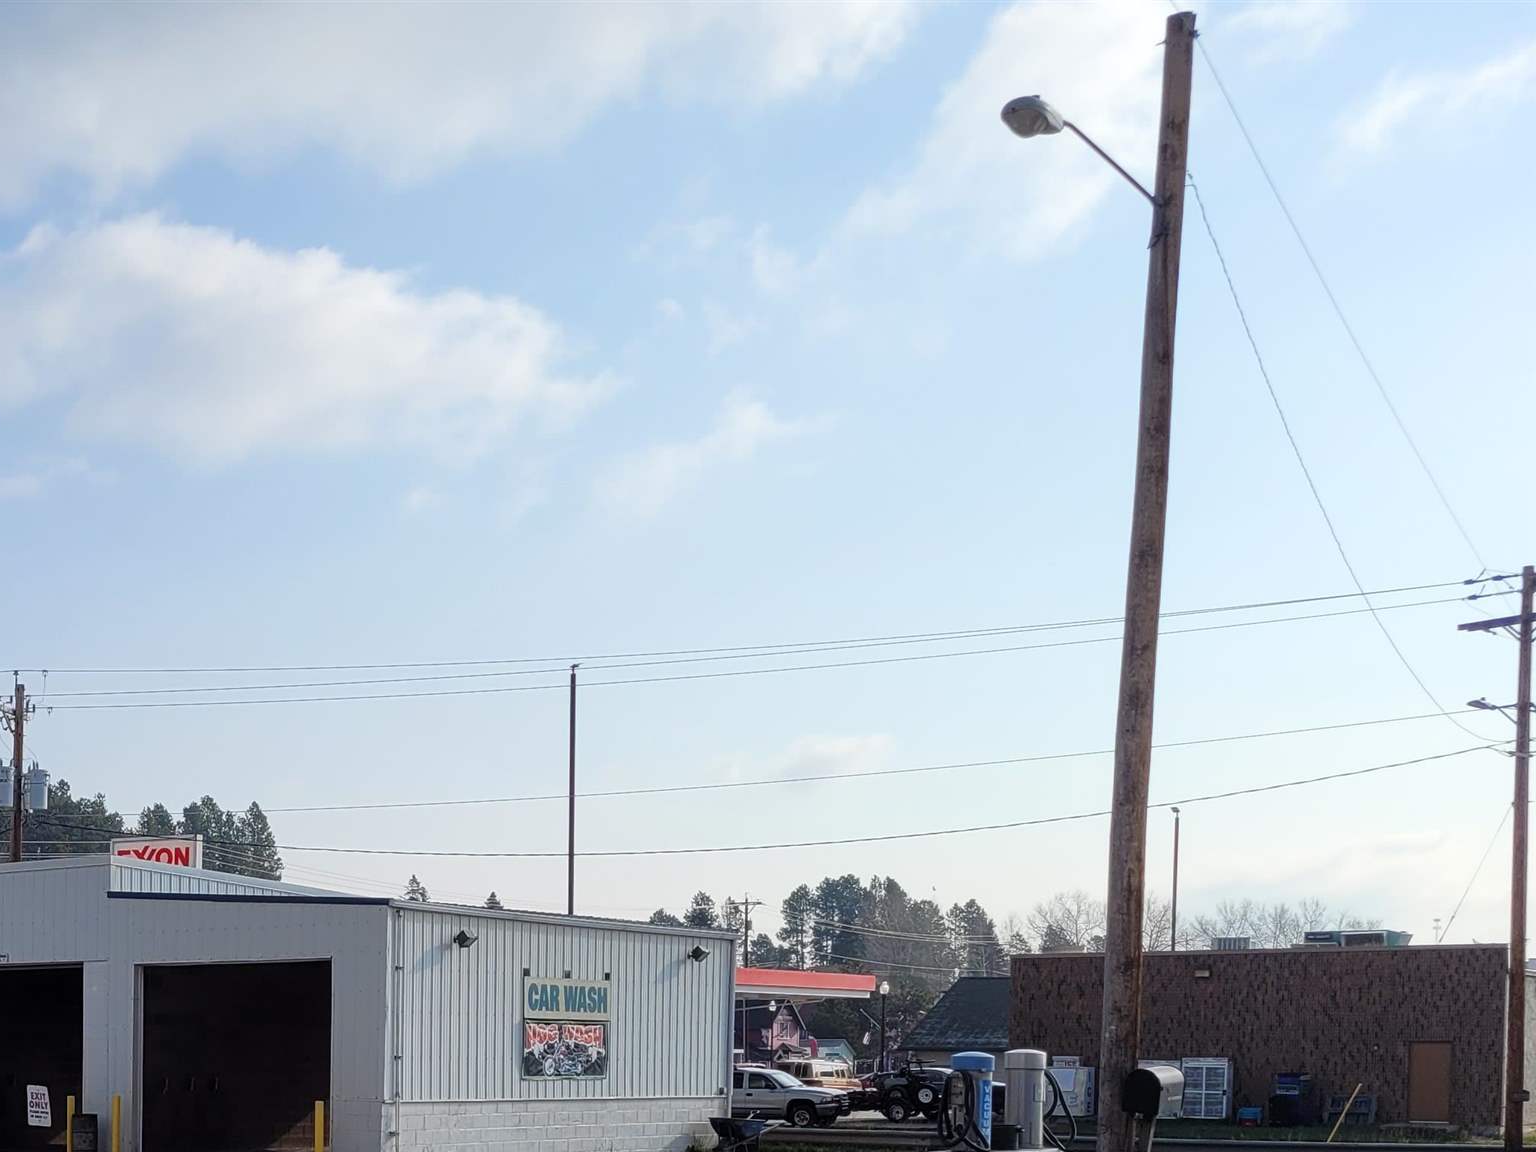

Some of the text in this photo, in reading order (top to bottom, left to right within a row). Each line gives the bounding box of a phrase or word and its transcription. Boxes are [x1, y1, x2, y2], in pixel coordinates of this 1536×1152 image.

[528, 983, 607, 1013] CAR WASH
[562, 1024, 604, 1049] WASH
[30, 1092, 46, 1101] EXIT
[29, 1101, 48, 1110] ONLY
